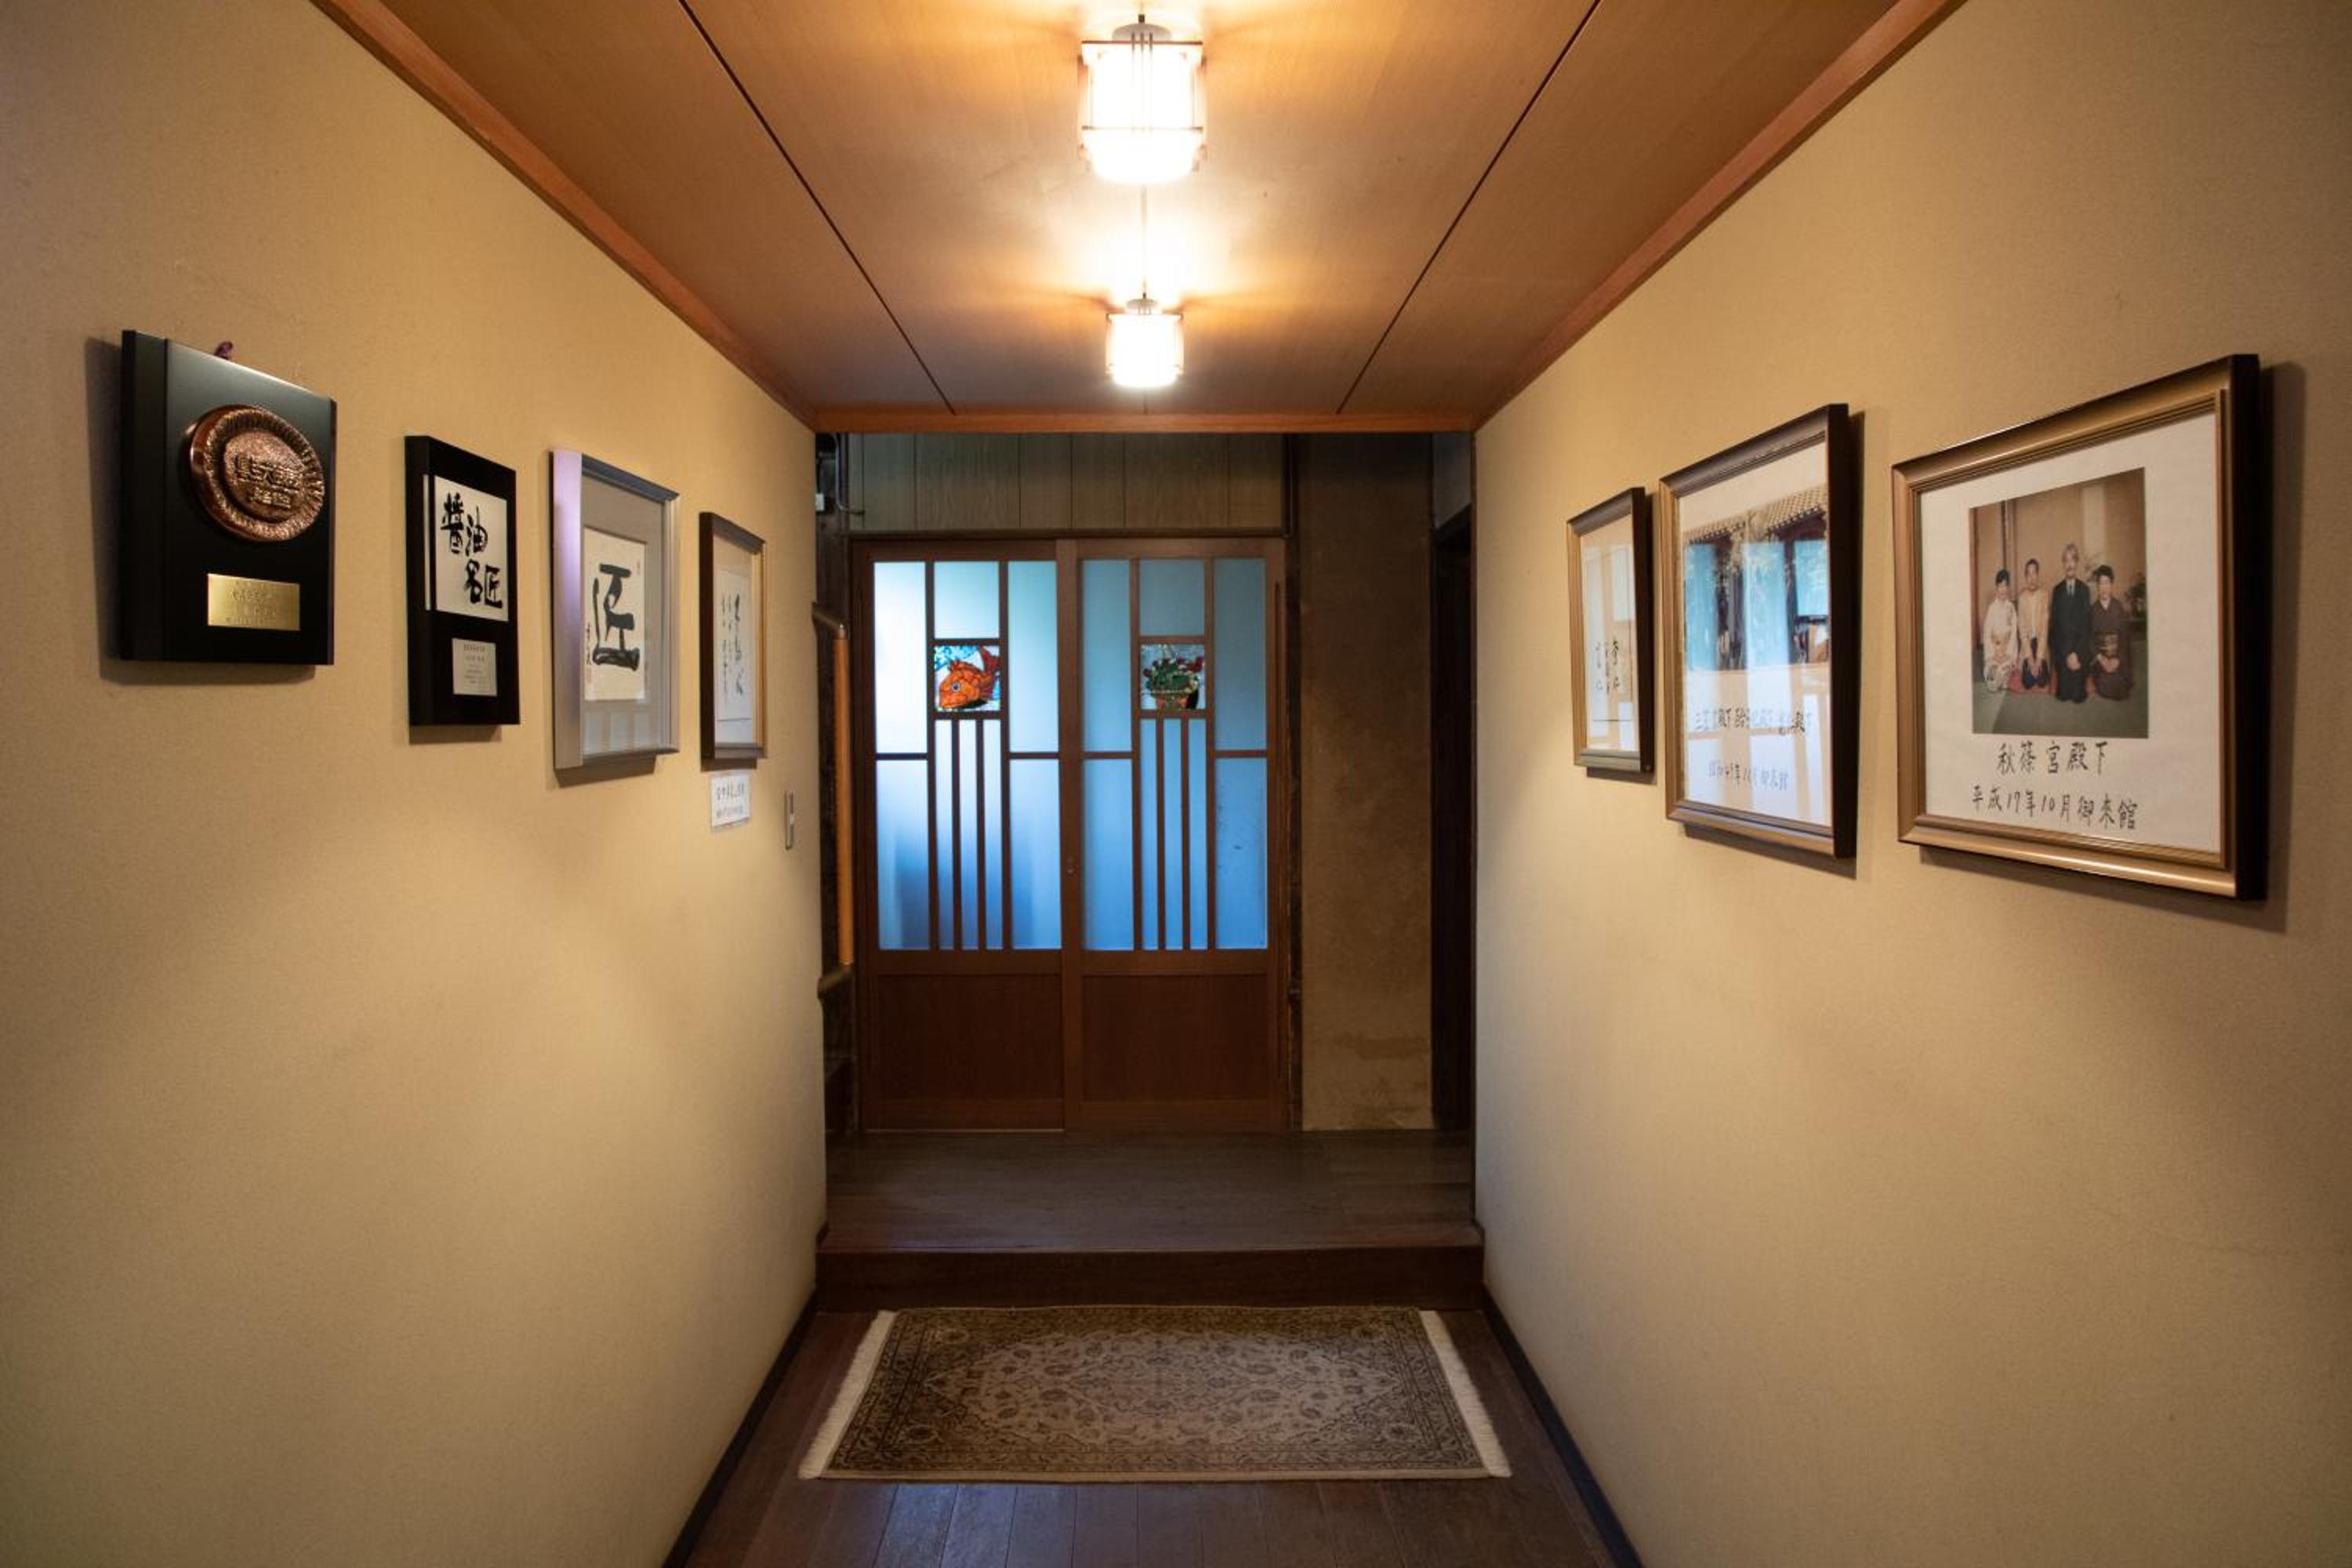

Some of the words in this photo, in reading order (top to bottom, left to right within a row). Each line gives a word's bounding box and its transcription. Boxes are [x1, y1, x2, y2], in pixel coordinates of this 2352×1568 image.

[1996, 739, 2109, 776] 秋篠宮殿下
[1970, 784, 2139, 831] 平成17年10月御来館
